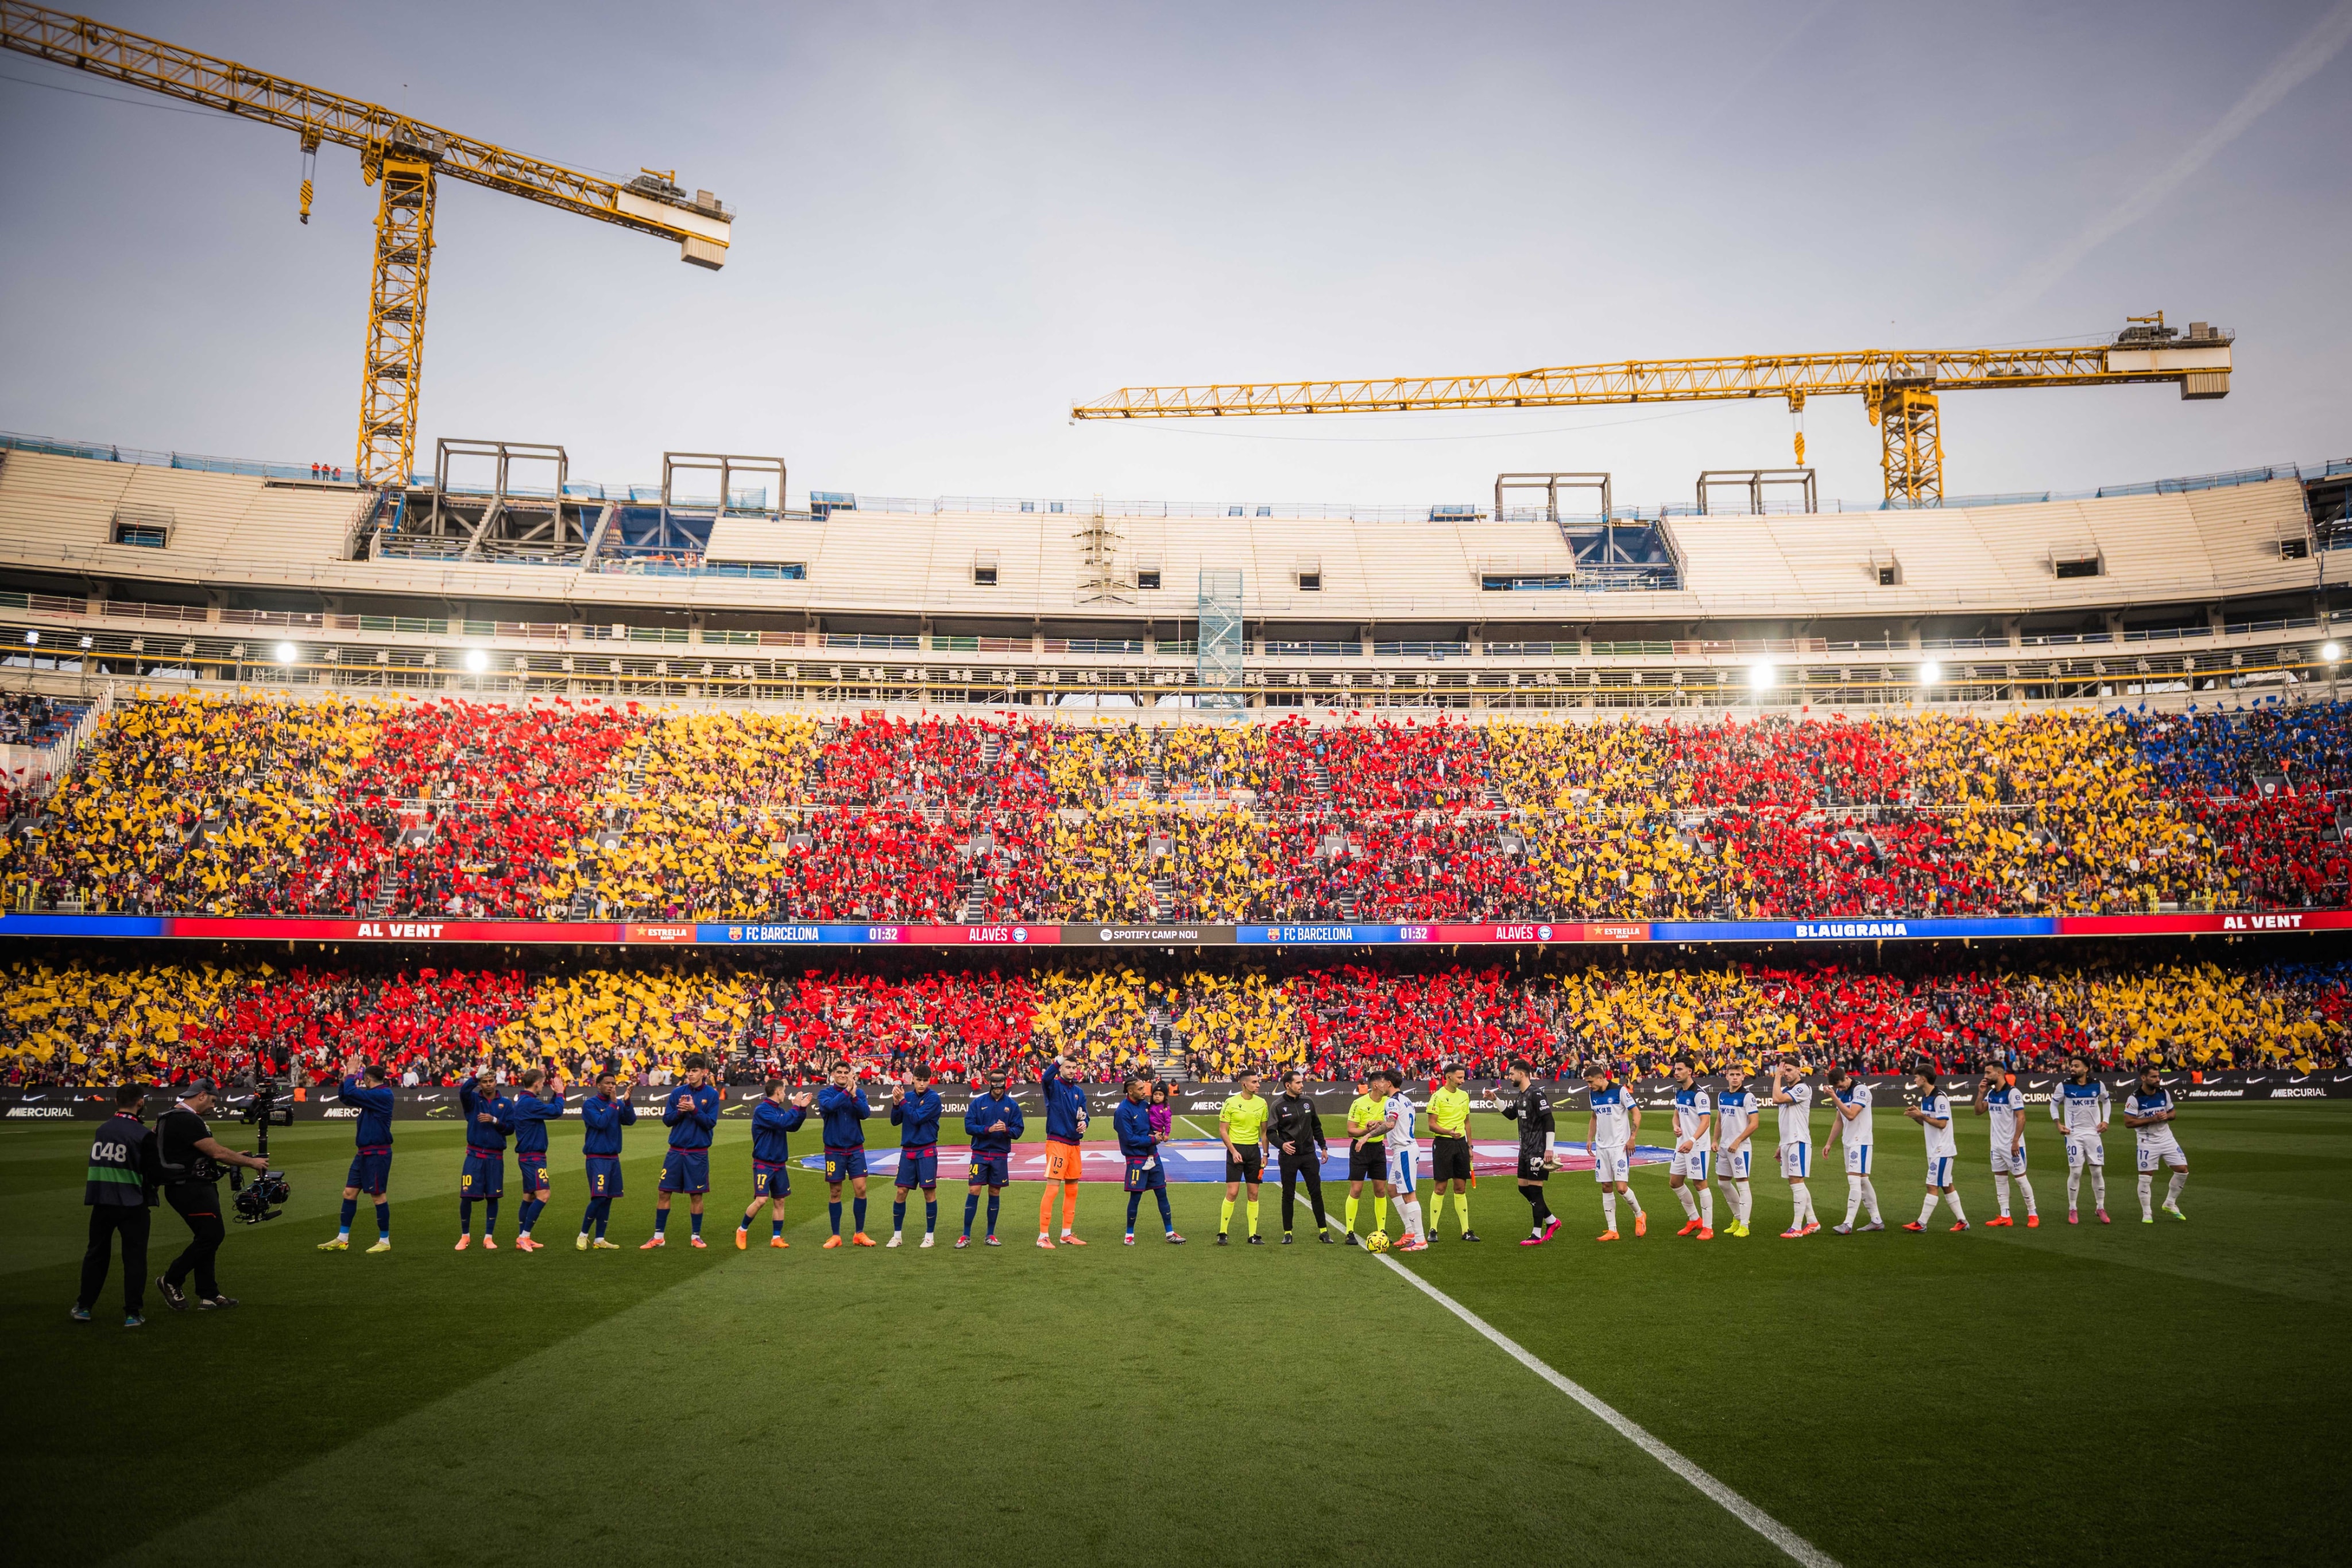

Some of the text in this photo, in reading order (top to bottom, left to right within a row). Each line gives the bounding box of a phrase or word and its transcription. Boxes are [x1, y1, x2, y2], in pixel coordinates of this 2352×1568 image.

[2223, 915, 2302, 929] AL VENT
[358, 924, 444, 938] AL VENT
[648, 928, 687, 936] ESTRELLA
[746, 927, 819, 940] FC BARCELONA
[869, 928, 898, 940] 01:32
[969, 926, 1008, 941] ALAVÉS
[1113, 930, 1198, 939] SPOTIFY CAMP NOU
[1284, 928, 1352, 940] FC BARCELONA
[1401, 927, 1428, 939] 01:32
[1496, 924, 1533, 939] ALAVÉS
[1796, 923, 1907, 938] BLAUGRANA
[2270, 1087, 2327, 1097] MERCURIAL
[6, 1108, 75, 1117] MERCURIAL
[91, 1141, 127, 1162] 048
[2067, 1145, 2077, 1155] 20
[2140, 1150, 2149, 1160] 17
[826, 1161, 835, 1172] 18
[1054, 1156, 1063, 1168] 13
[969, 1164, 978, 1175] 24
[1132, 1169, 1140, 1181] 11
[462, 1175, 472, 1186] 10
[597, 1174, 604, 1186] 3
[757, 1174, 767, 1185] 17
